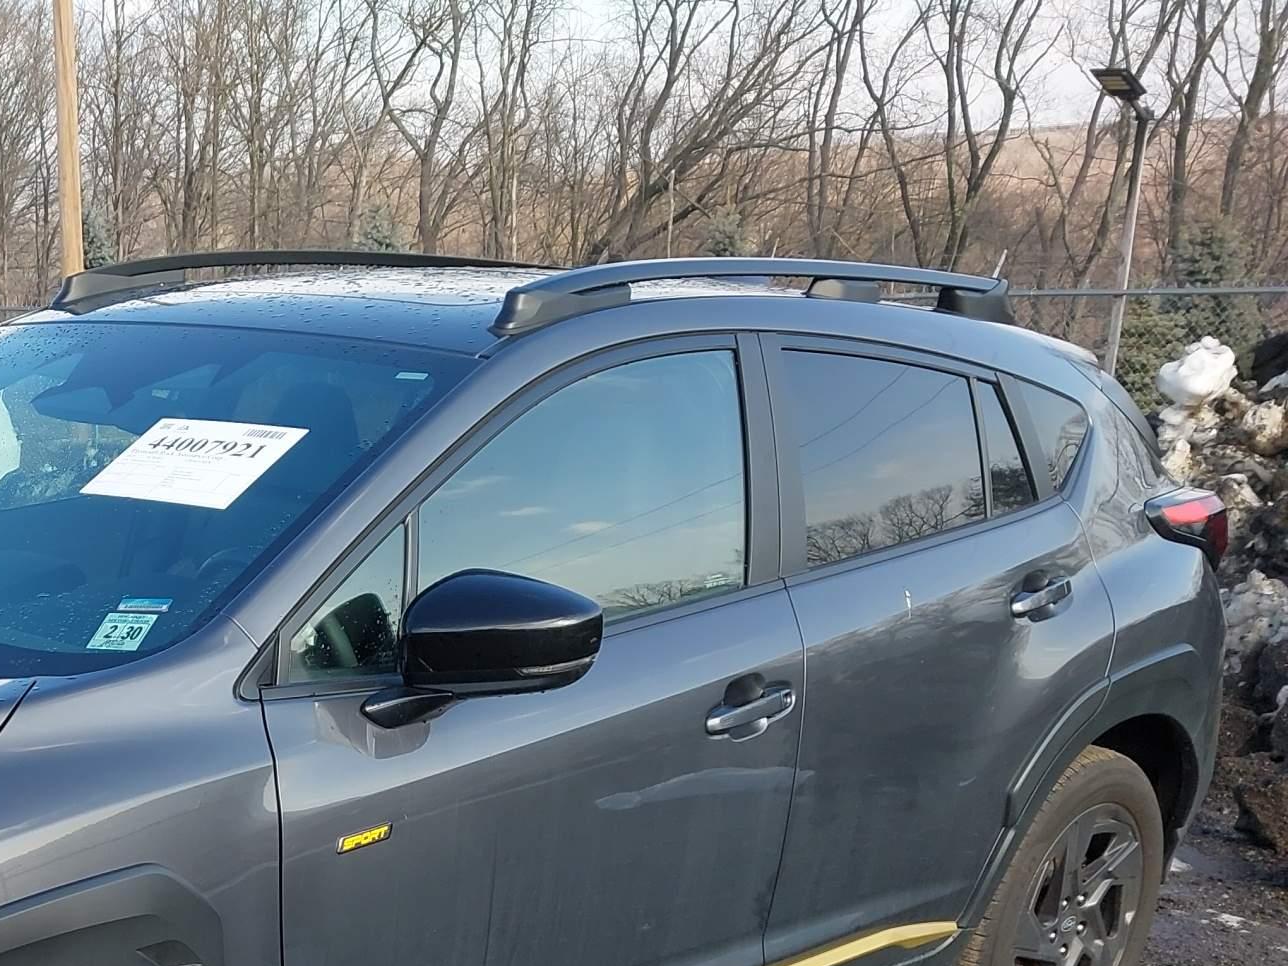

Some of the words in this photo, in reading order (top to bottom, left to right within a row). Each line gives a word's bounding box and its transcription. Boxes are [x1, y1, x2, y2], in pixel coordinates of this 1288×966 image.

[147, 435, 267, 459] 44007921
[103, 624, 119, 639] 2
[121, 625, 143, 641] 30
[342, 825, 389, 852] SPORT
